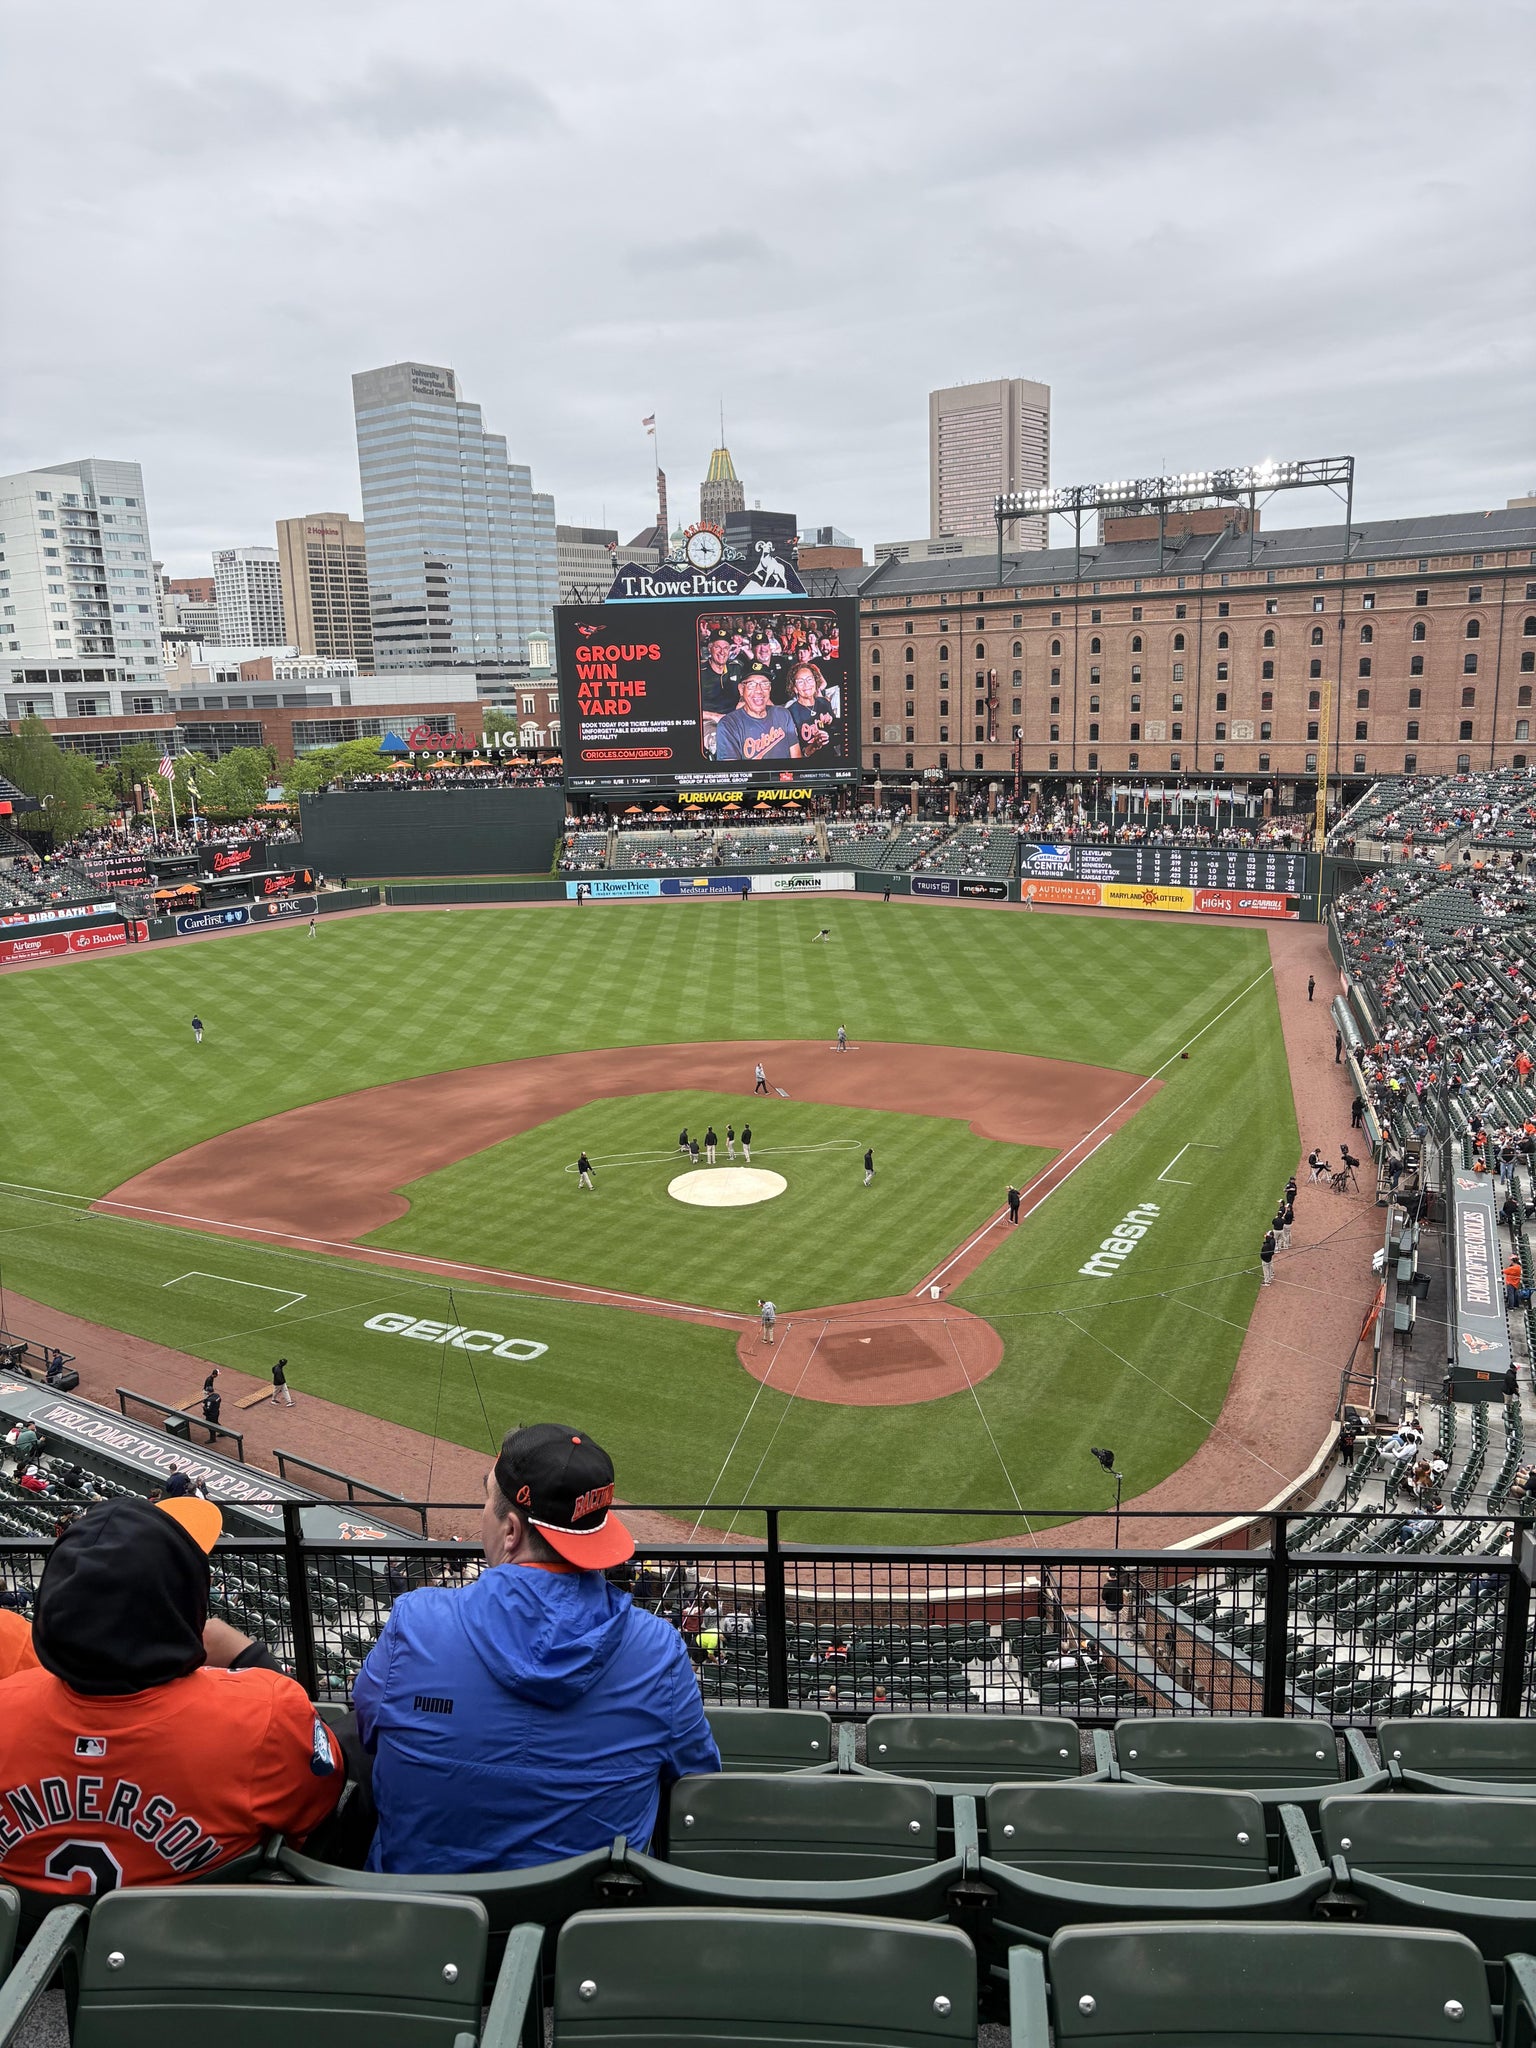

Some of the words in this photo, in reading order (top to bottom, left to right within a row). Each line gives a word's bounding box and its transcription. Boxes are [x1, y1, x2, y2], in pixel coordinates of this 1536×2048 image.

[312, 527, 338, 536] Hopkins
[683, 520, 724, 538] ORIOLES
[576, 644, 661, 662] GROUPS
[576, 664, 617, 680] WIN
[578, 682, 602, 698] AT
[606, 681, 646, 696] THE
[578, 699, 632, 716] YARD
[408, 724, 478, 750] Coors
[482, 730, 546, 748] LIGHT
[743, 726, 786, 759] Orioles
[409, 751, 456, 760] ROOF
[472, 748, 519, 758] DECK
[586, 750, 668, 758] ORIOLES.COM/GROUPS
[678, 792, 744, 804] PUREWAGER
[756, 788, 812, 800] PAVILION
[1021, 861, 1032, 869] AL
[1034, 862, 1074, 871] CENTRAL
[680, 886, 708, 894] MedStar
[918, 882, 940, 890] TRUIST
[1038, 886, 1073, 894] AUTUMN
[1076, 888, 1096, 896] LAKE
[1110, 892, 1142, 900] MARYLAND
[1202, 898, 1232, 910] HIGH'S
[1252, 900, 1282, 908] CARROLL
[279, 900, 300, 912] PNC
[28, 912, 56, 922] BIRD
[58, 908, 86, 918] BATH
[184, 914, 224, 930] CareFirst
[14, 940, 42, 950] Airtemp
[1463, 1211, 1486, 1244] ORIOLES
[1465, 1244, 1487, 1263] THE
[1466, 1260, 1488, 1276] OF
[1467, 1274, 1490, 1304] HOME
[364, 1312, 549, 1360] GEICO
[43, 1404, 140, 1449] WELCOME
[130, 1440, 164, 1460] TO
[154, 1452, 237, 1491] ORIOLE
[221, 1480, 287, 1514] PARK
[414, 1696, 454, 1714] PUMA
[0, 1775, 223, 1872] ENDERSON
